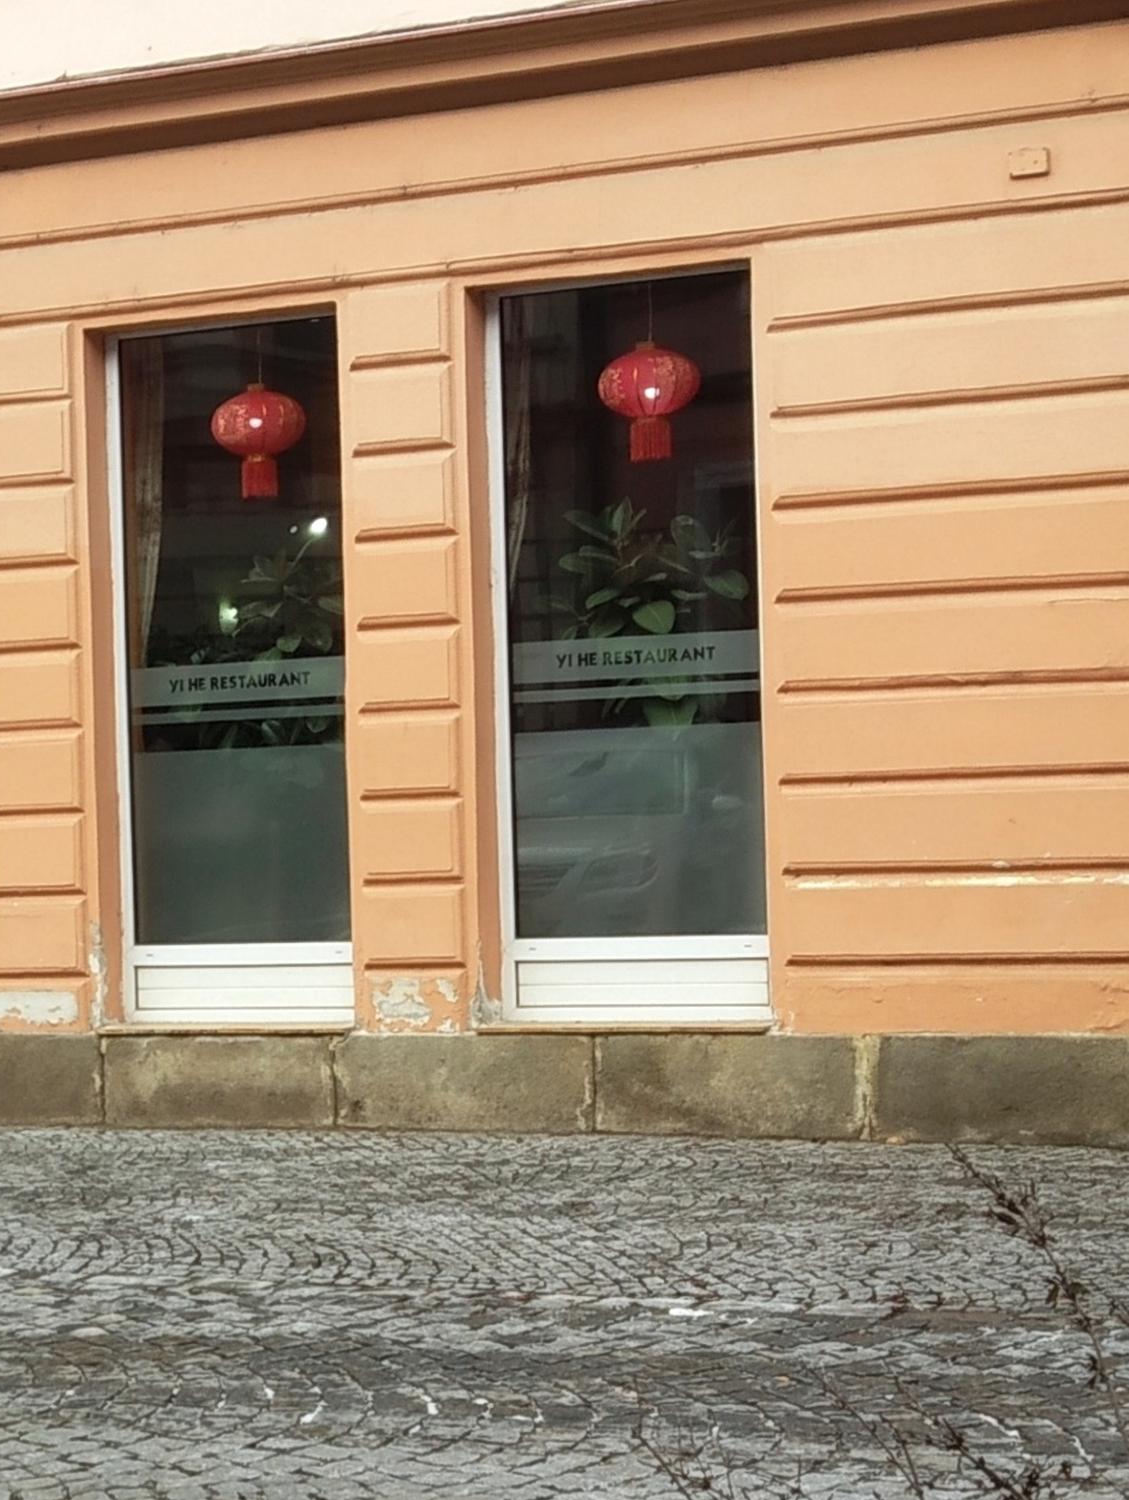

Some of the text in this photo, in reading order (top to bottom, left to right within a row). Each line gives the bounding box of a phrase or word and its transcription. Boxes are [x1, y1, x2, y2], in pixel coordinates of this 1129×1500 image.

[556, 645, 716, 669] YI HE RESTAURANT
[169, 671, 311, 693] YI HE RESTAURANT
